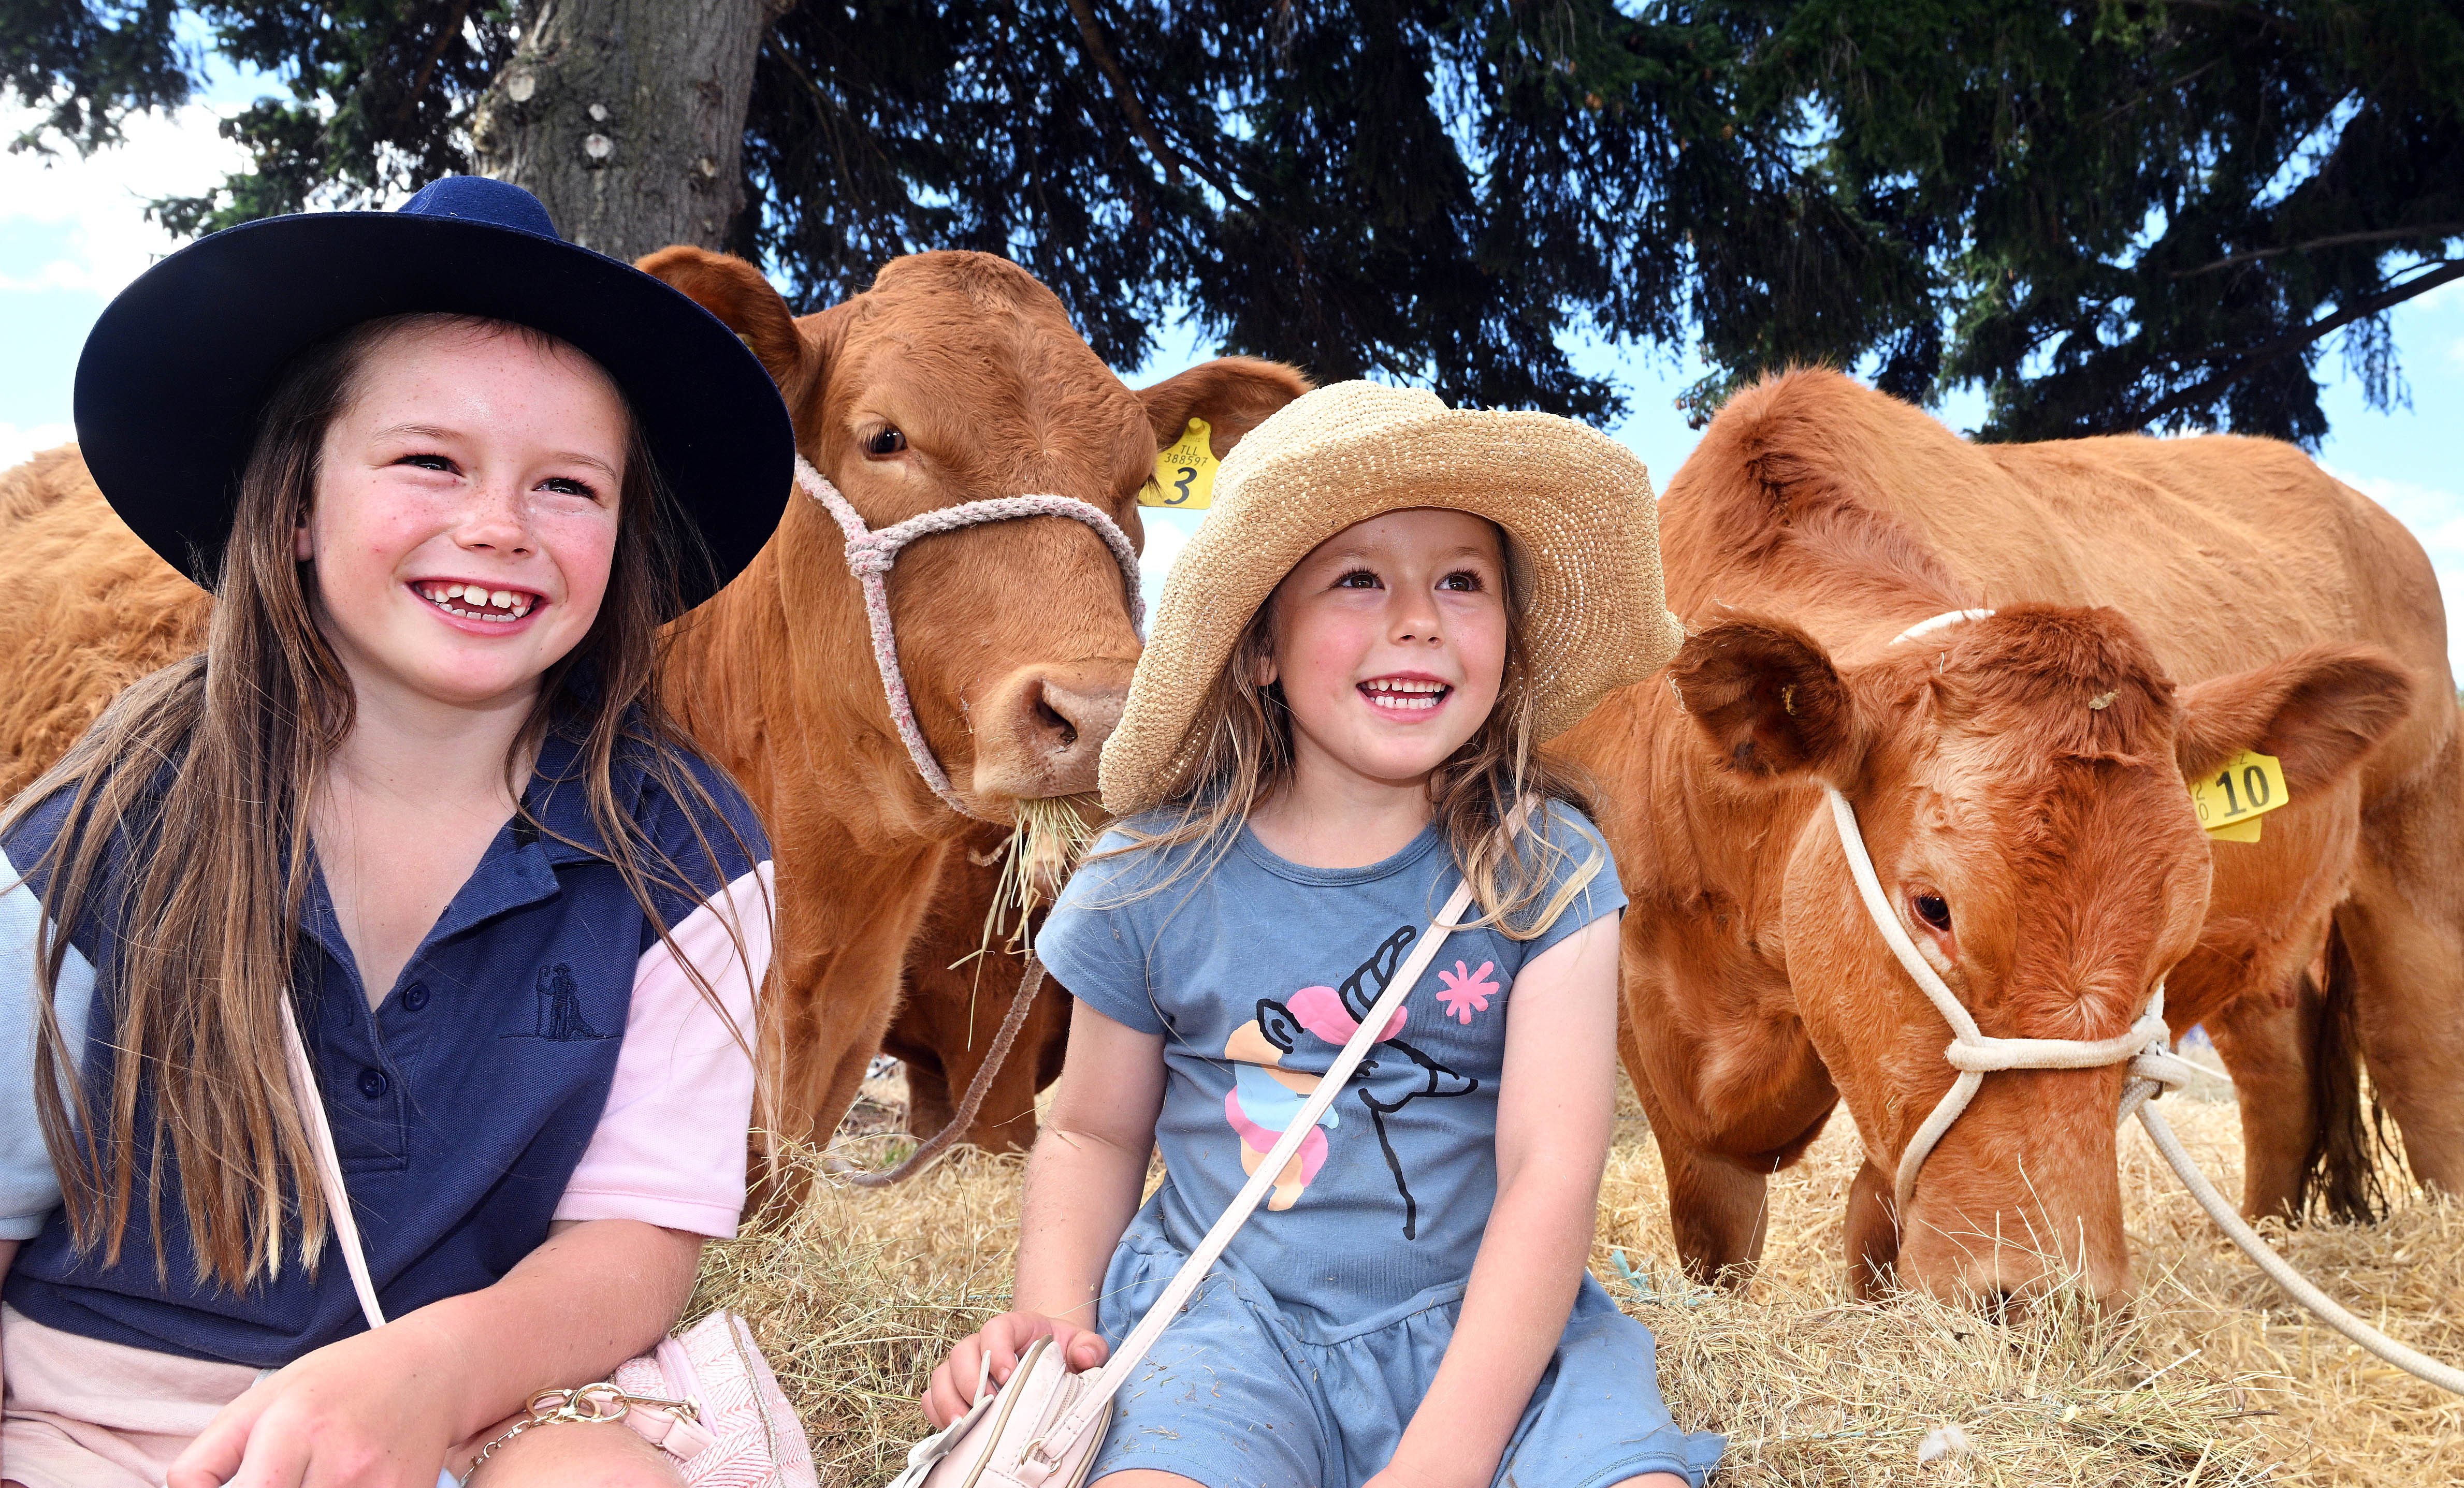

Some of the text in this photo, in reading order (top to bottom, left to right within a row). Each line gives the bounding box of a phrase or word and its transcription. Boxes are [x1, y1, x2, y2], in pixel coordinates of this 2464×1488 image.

[1164, 453, 1208, 466] 388597
[1180, 445, 1197, 456] TLL
[1164, 467, 1197, 505] 3
[2216, 765, 2269, 818] 10
